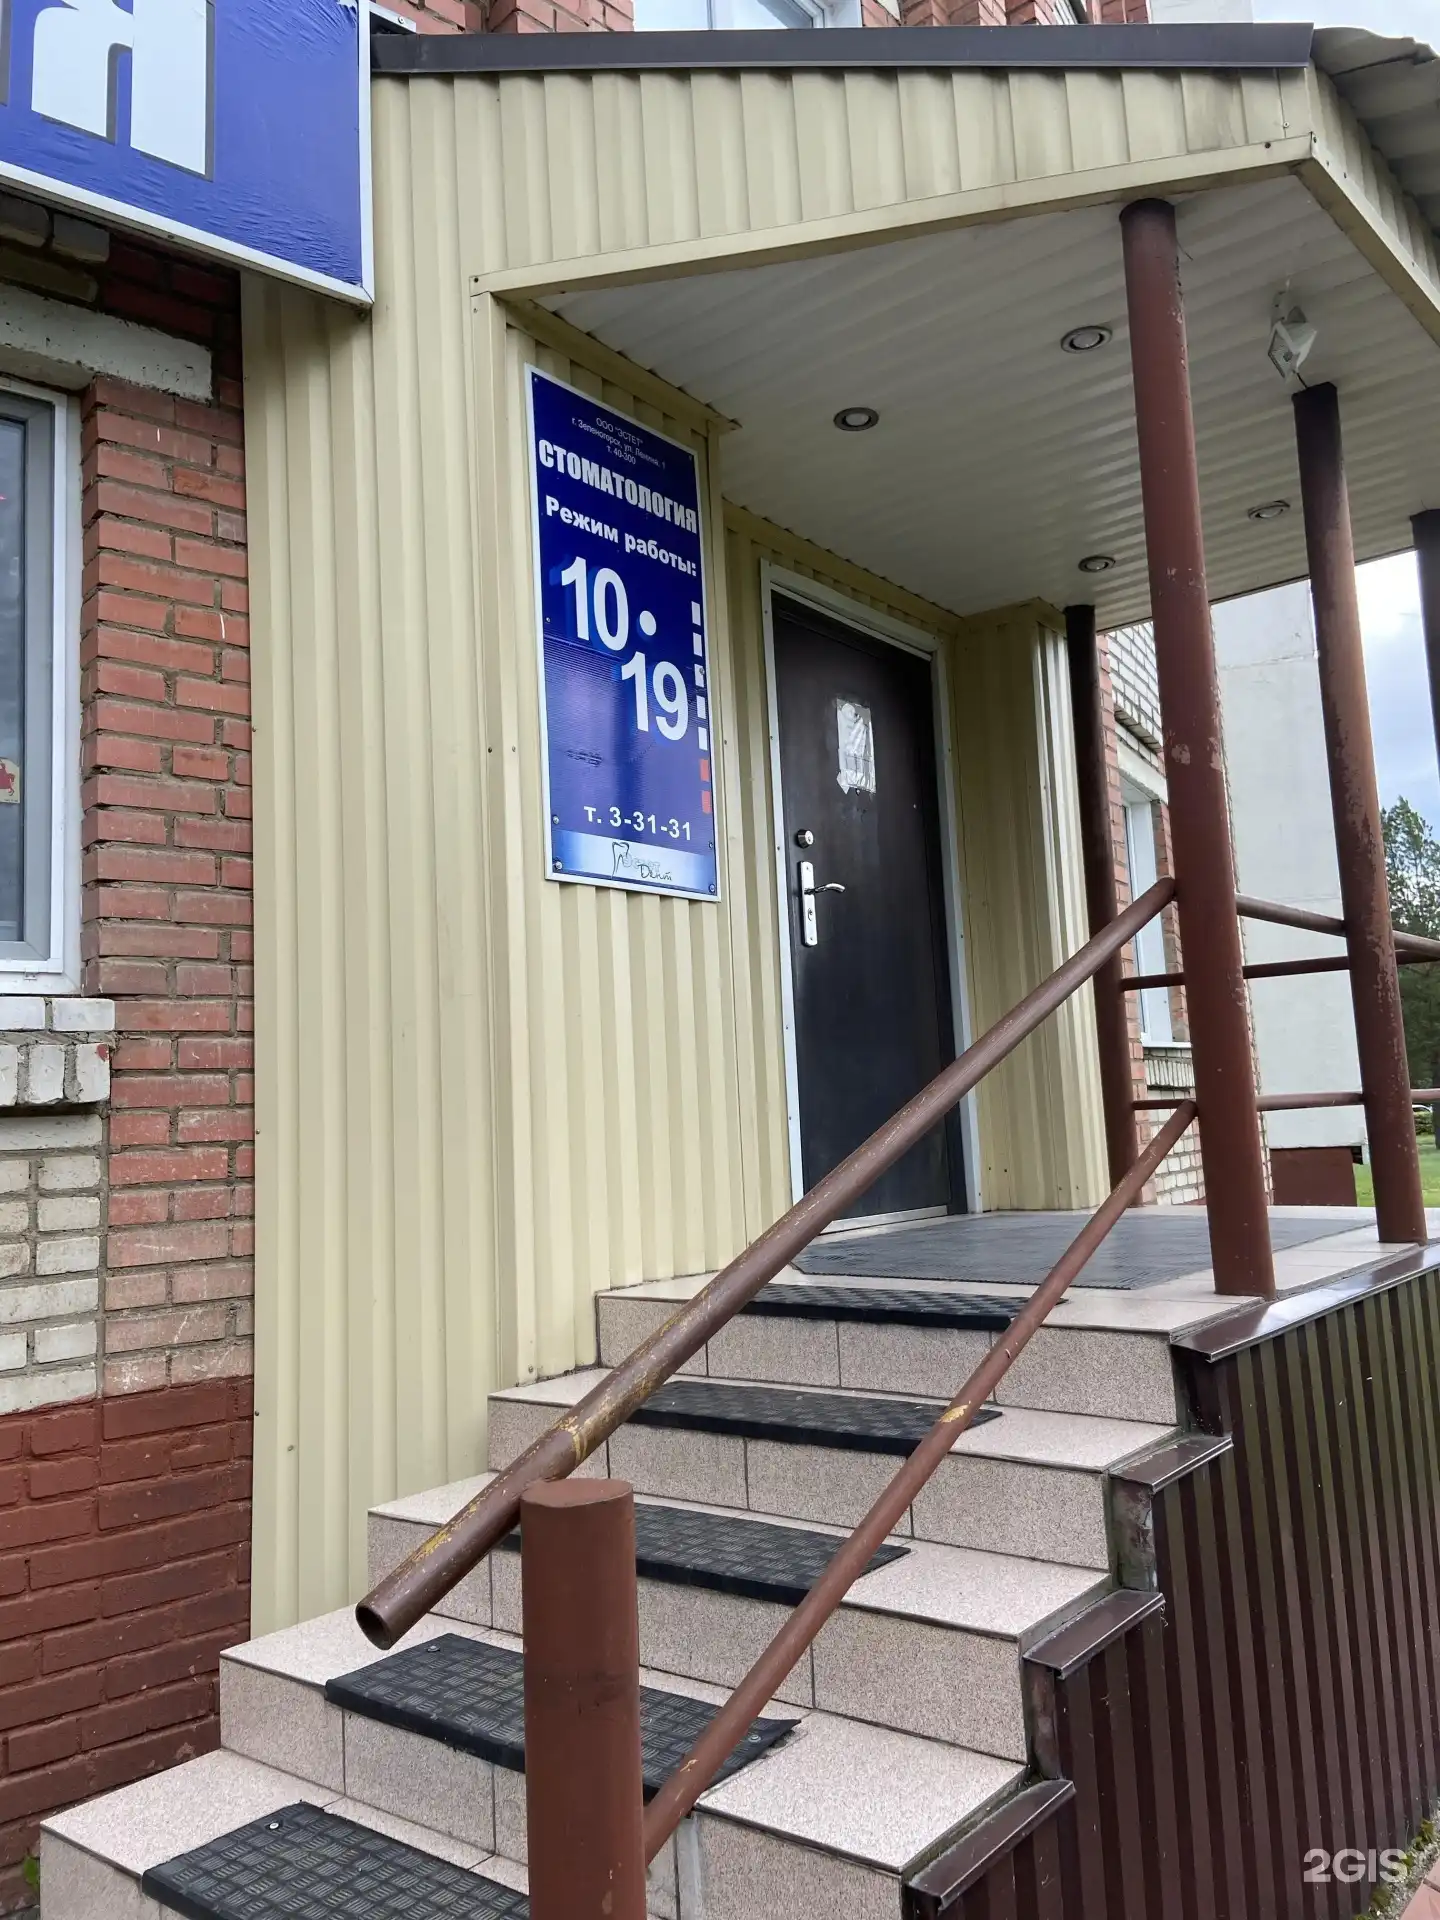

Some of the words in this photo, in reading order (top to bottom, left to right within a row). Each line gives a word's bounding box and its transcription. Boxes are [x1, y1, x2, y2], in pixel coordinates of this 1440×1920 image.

[596, 417, 614, 433] ООО
[538, 439, 697, 534] СТОМАТОЛОГИЯ
[546, 494, 619, 543] Режим
[625, 532, 697, 576] работы:
[621, 651, 688, 741] 19
[583, 805, 602, 824] т.
[609, 806, 691, 841] 3-31-31
